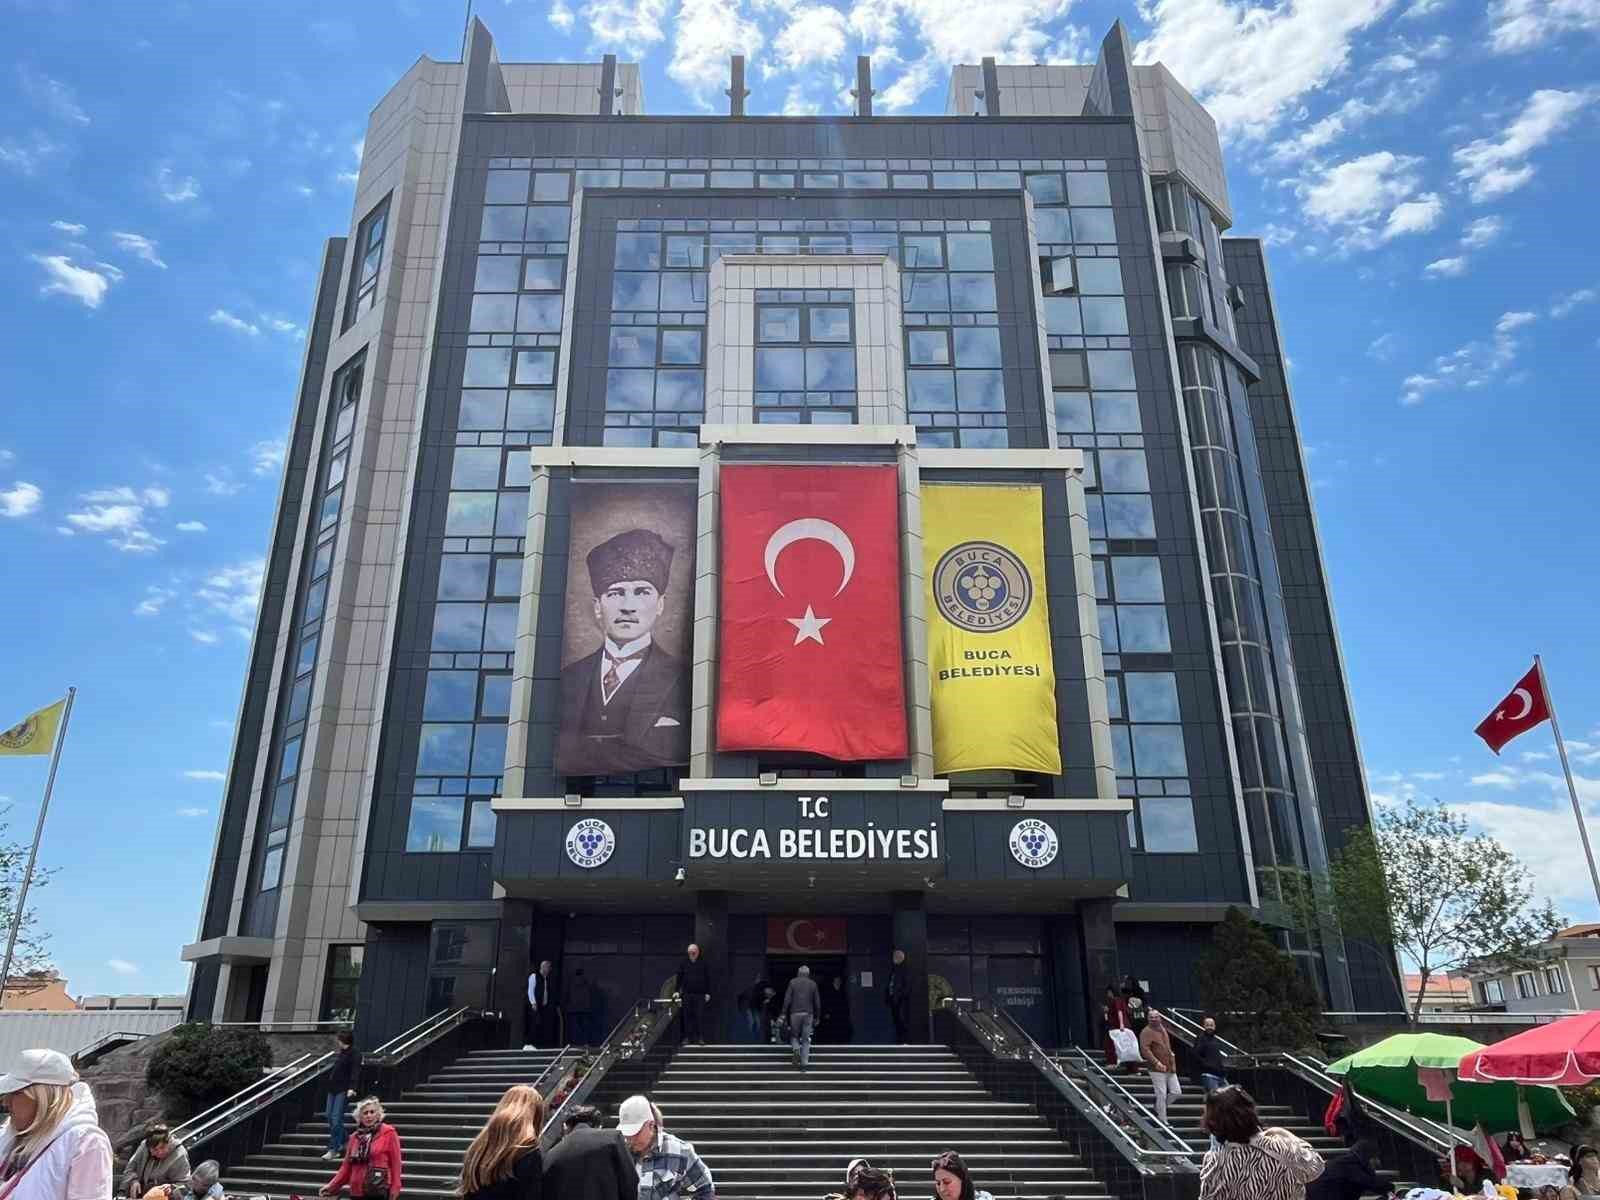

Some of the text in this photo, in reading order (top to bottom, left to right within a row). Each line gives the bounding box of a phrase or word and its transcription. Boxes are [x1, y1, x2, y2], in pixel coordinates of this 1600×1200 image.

[955, 551, 1002, 566] BUCA
[964, 649, 1012, 661] BUCA
[939, 664, 1041, 681] BELEDİYESİ
[798, 796, 829, 818] T.C
[577, 820, 606, 831] BUCA
[1018, 820, 1047, 831] BUCA
[688, 822, 939, 859] BUCA BELEDİYESİ
